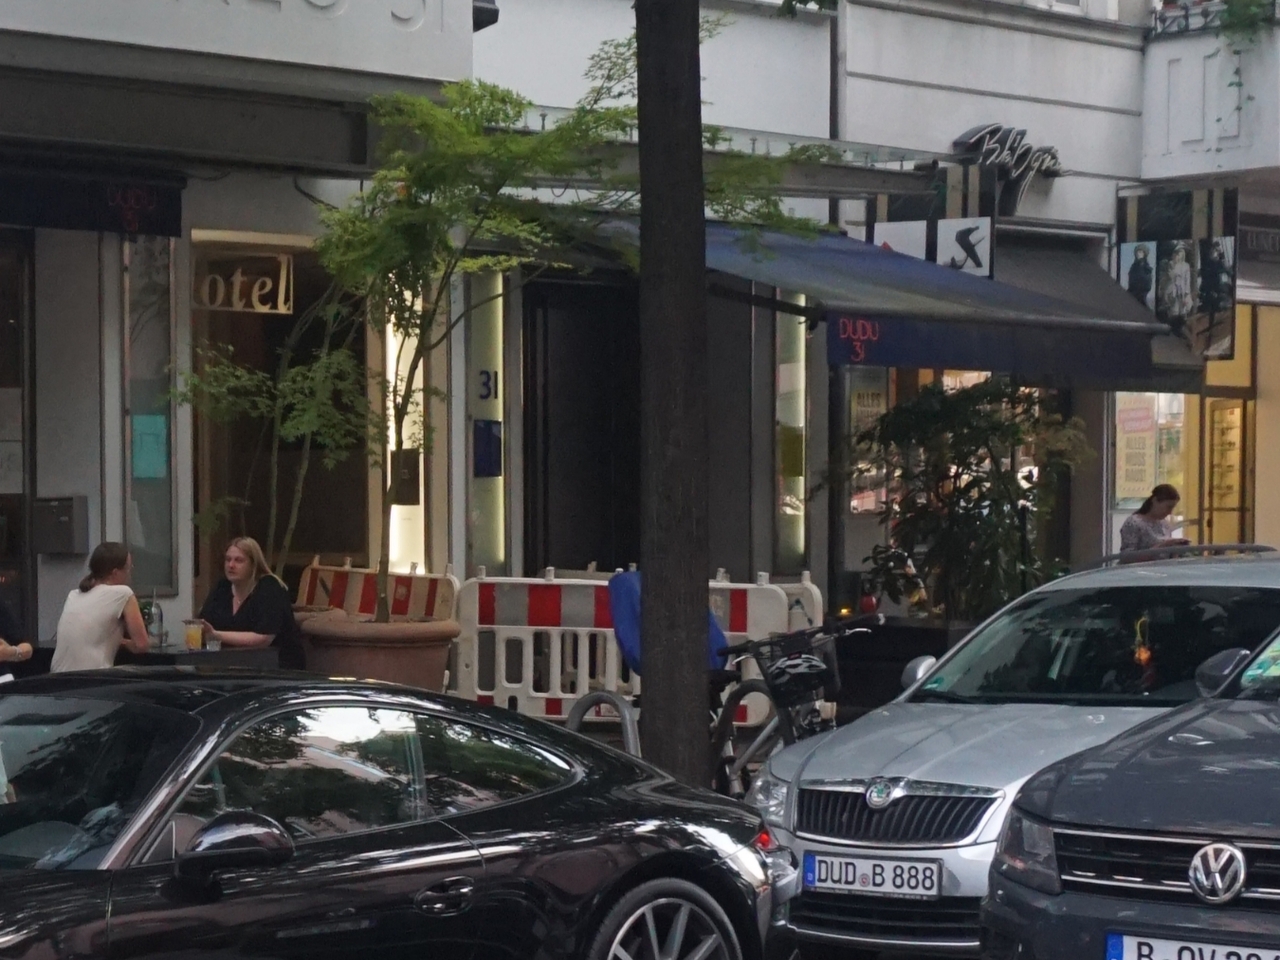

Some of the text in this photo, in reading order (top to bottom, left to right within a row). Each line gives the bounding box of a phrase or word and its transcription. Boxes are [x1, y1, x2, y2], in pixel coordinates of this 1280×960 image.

[839, 317, 879, 340] DUDU
[851, 341, 866, 362] 31
[479, 370, 498, 400] 31
[816, 859, 857, 886] DUD
[871, 863, 886, 888] B
[891, 864, 935, 891] 888
